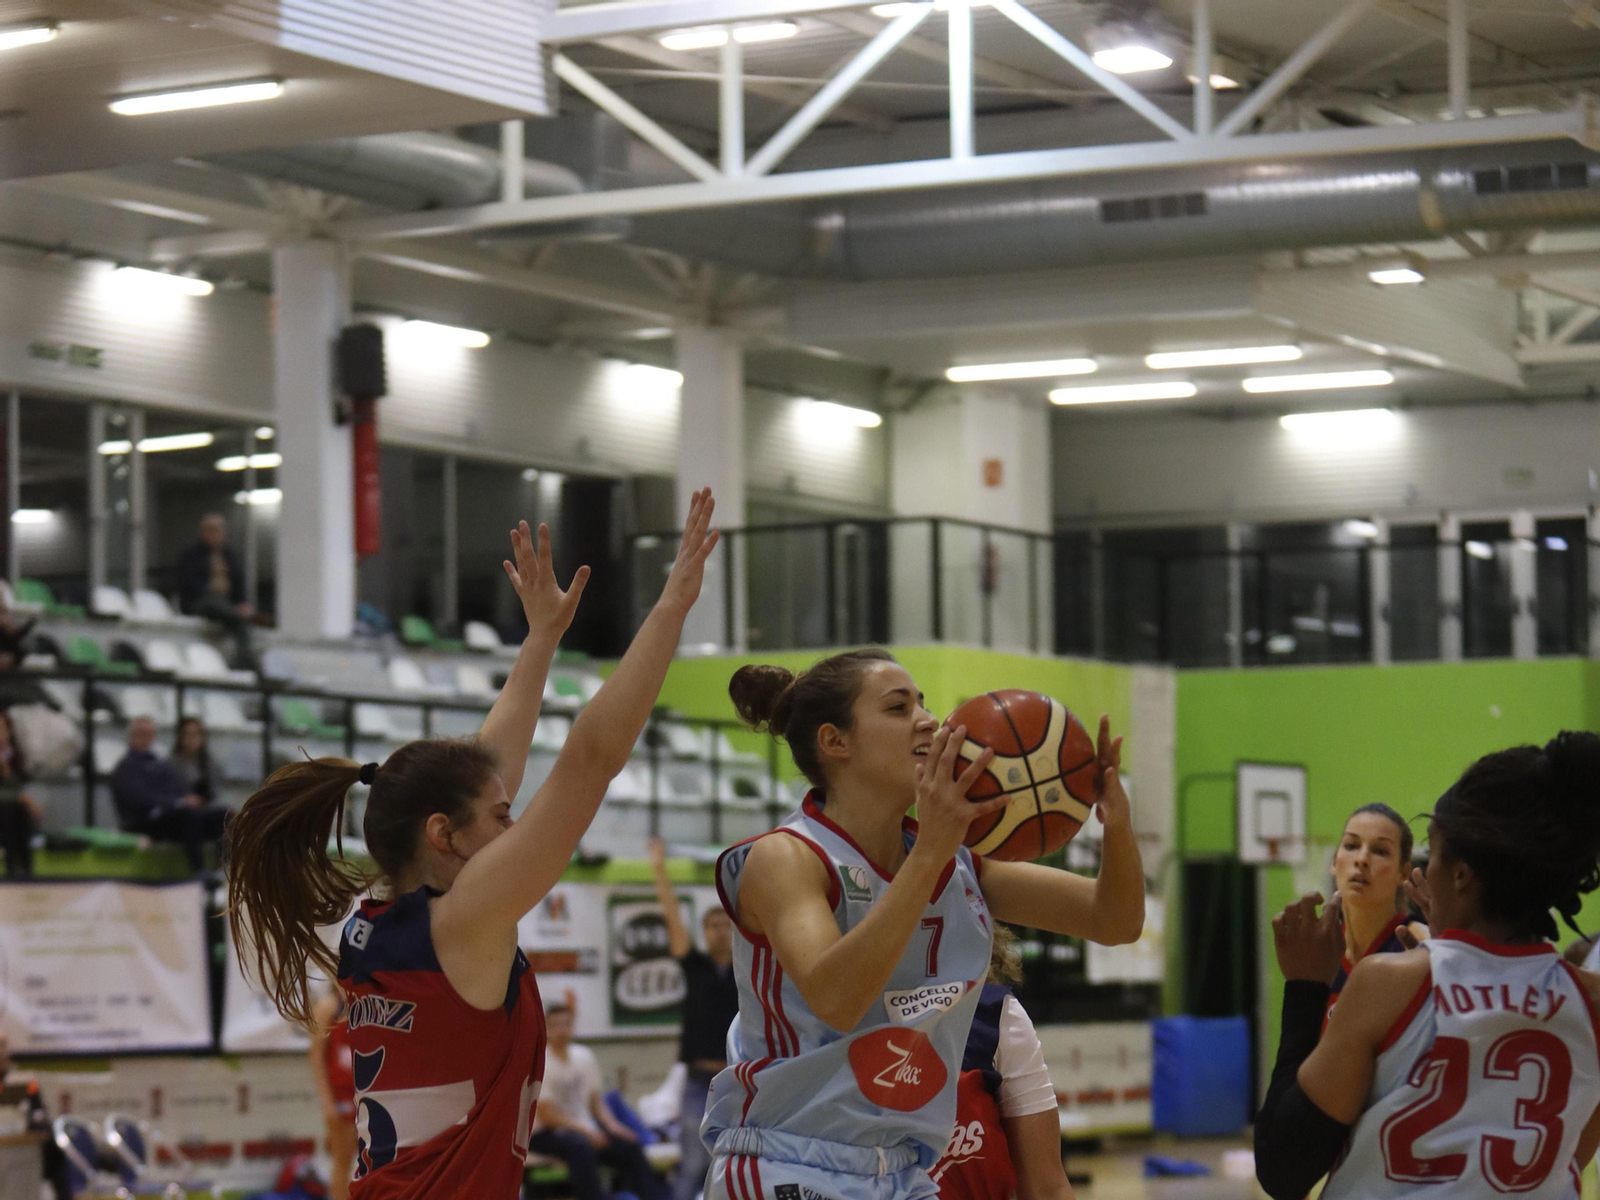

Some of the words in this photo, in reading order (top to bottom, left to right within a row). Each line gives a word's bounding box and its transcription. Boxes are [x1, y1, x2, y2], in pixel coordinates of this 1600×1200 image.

[921, 915, 945, 978] 7
[890, 984, 960, 1008] CONCELLO
[902, 1004, 920, 1017] DE
[921, 995, 953, 1013] VIGO
[1380, 1028, 1573, 1194] 23
